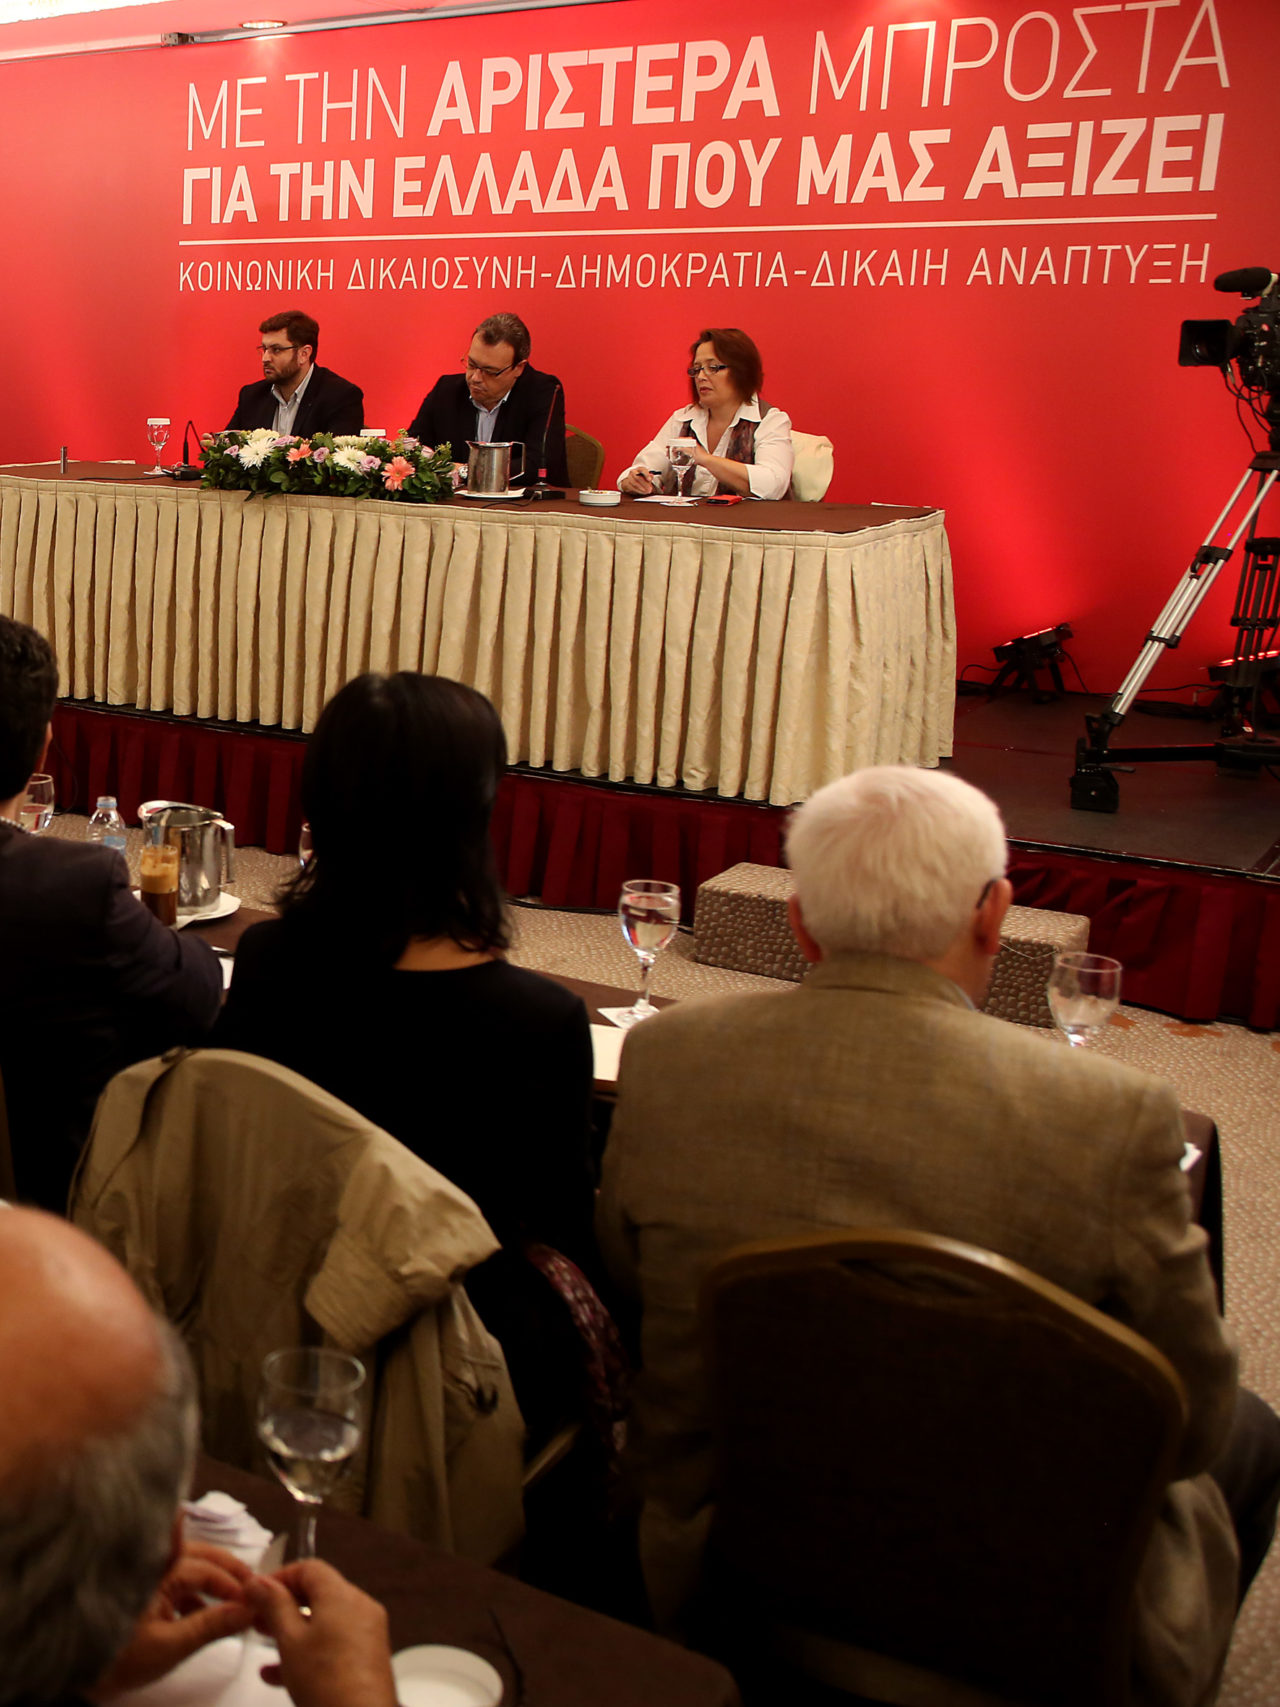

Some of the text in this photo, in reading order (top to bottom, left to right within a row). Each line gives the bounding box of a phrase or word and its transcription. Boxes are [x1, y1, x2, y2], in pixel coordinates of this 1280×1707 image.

[187, 0, 1230, 151] ΜΕ ΤΗΝ ΑΡΙΣΤΕΡΑ ΜΠΡΟΣΤΑ
[182, 113, 1225, 225] ΓΙΑ ΤΗΝ ΕΛΛΑΔΑ ΠΟΥ ΜΑΣ ΑΞΙΖΕΙ
[178, 259, 334, 292] ΚΟΙΝΩΝΙΚΗ
[966, 243, 1211, 286] ΑΝΑΠΤΥΞΗ
